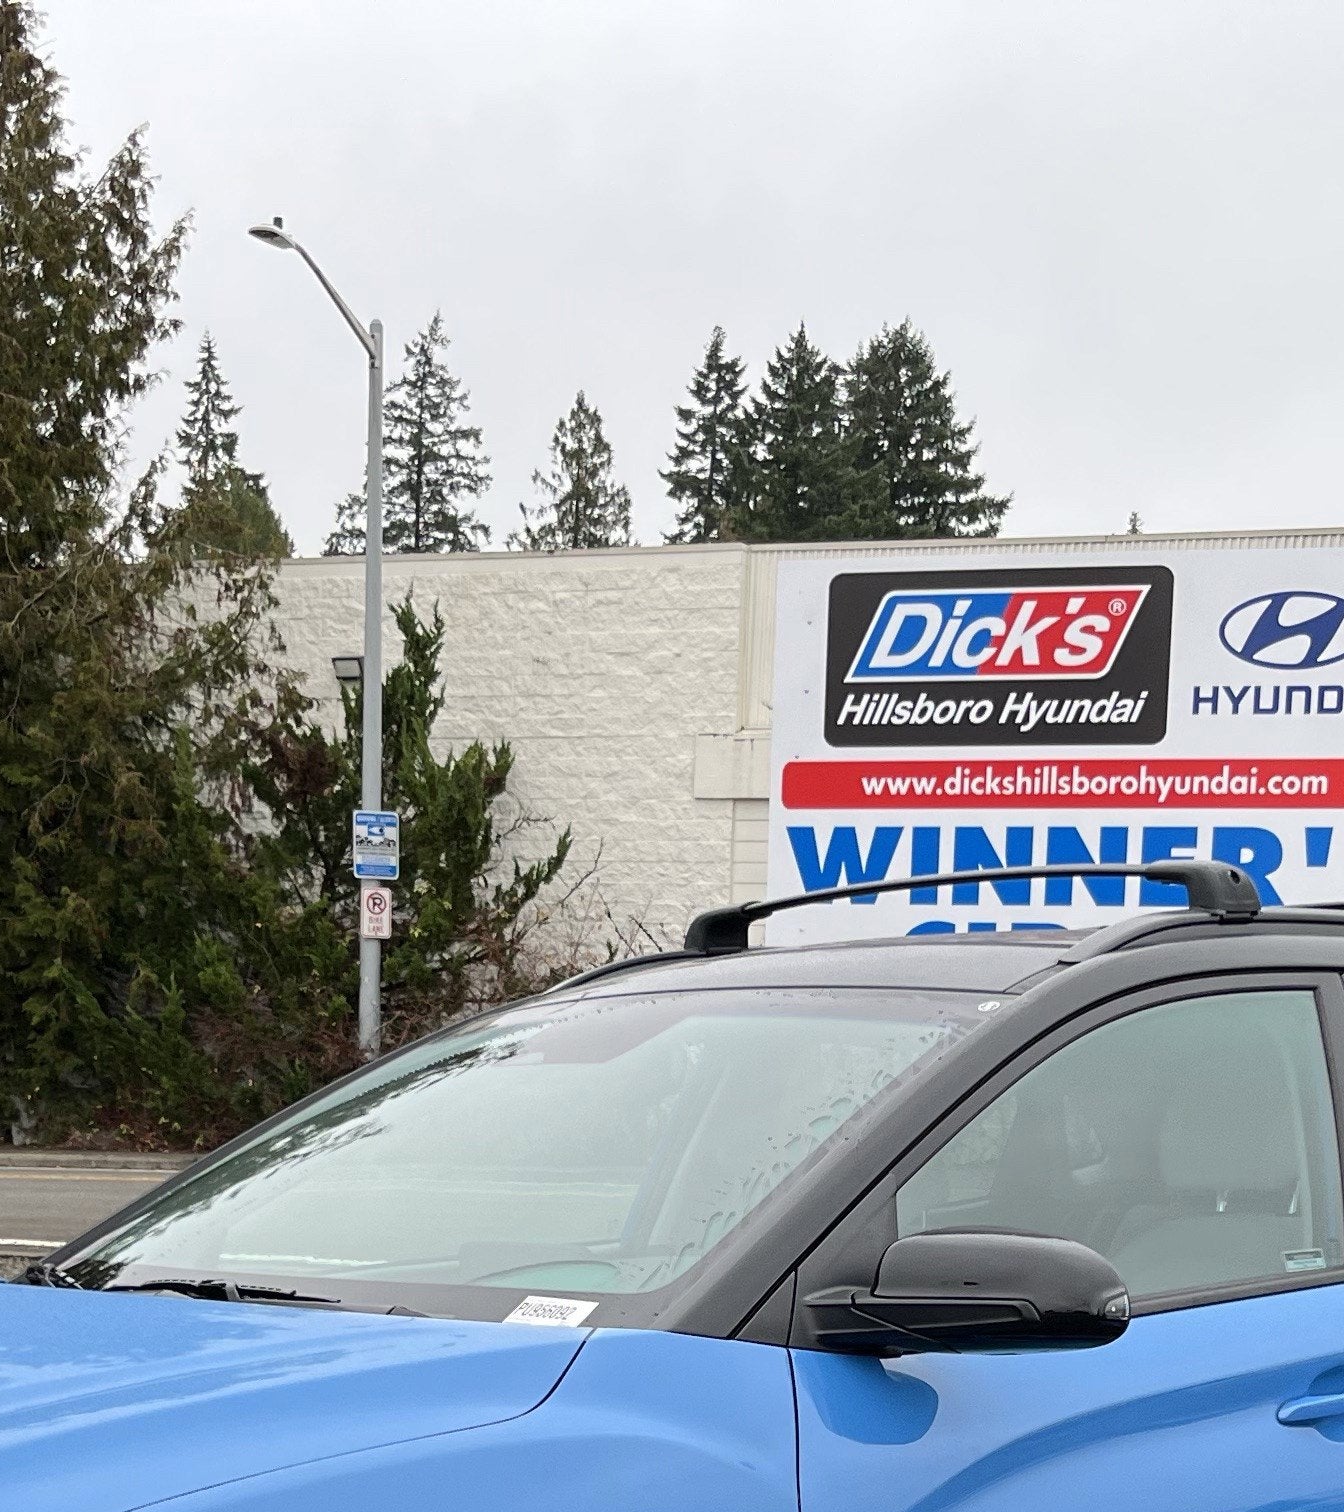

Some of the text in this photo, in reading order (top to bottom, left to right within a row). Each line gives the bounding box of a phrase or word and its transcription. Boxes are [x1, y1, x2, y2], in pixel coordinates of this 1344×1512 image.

[869, 596, 1112, 670] Dick's
[837, 690, 1150, 733] Hillsboro Hyundai
[861, 766, 1329, 804] www.dickshillsborohyundai.com
